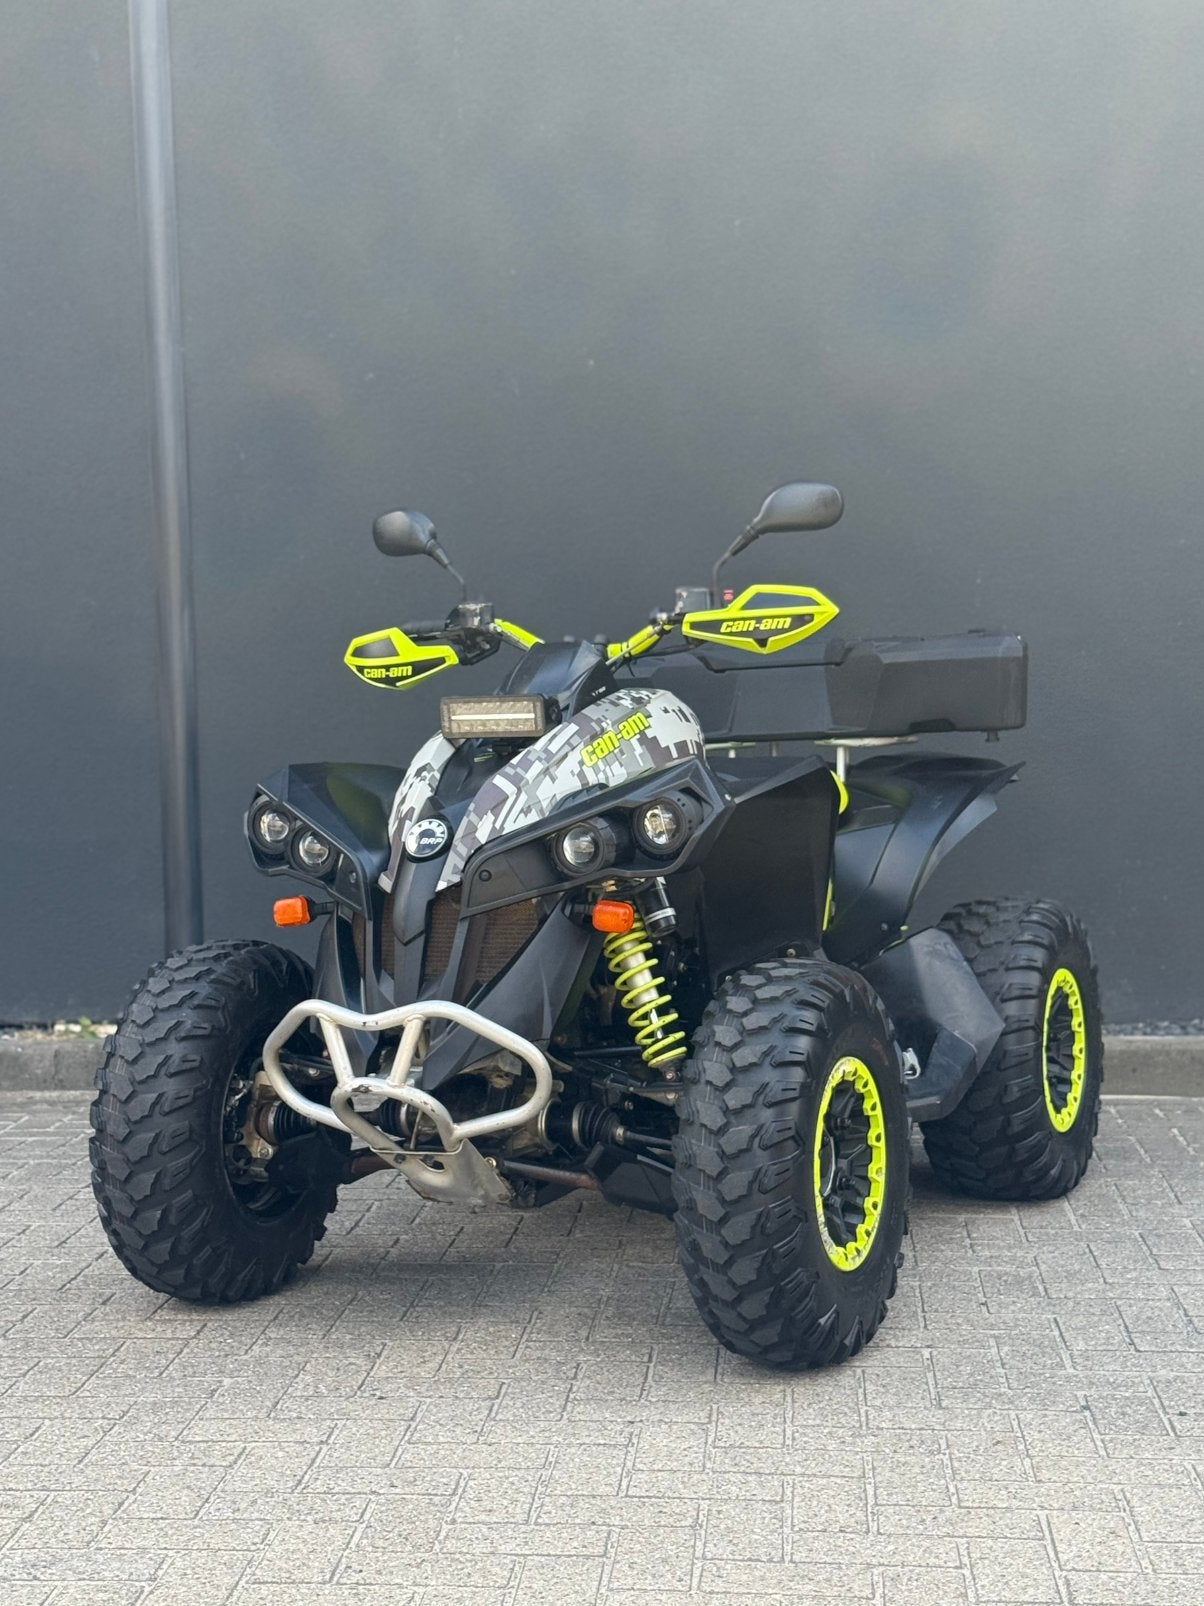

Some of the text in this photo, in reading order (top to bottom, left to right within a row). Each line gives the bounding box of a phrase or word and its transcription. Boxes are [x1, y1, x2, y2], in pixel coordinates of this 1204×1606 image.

[720, 617, 792, 633] can-am
[363, 665, 413, 679] can-am
[580, 712, 650, 767] can-am
[419, 837, 443, 845] BRP
